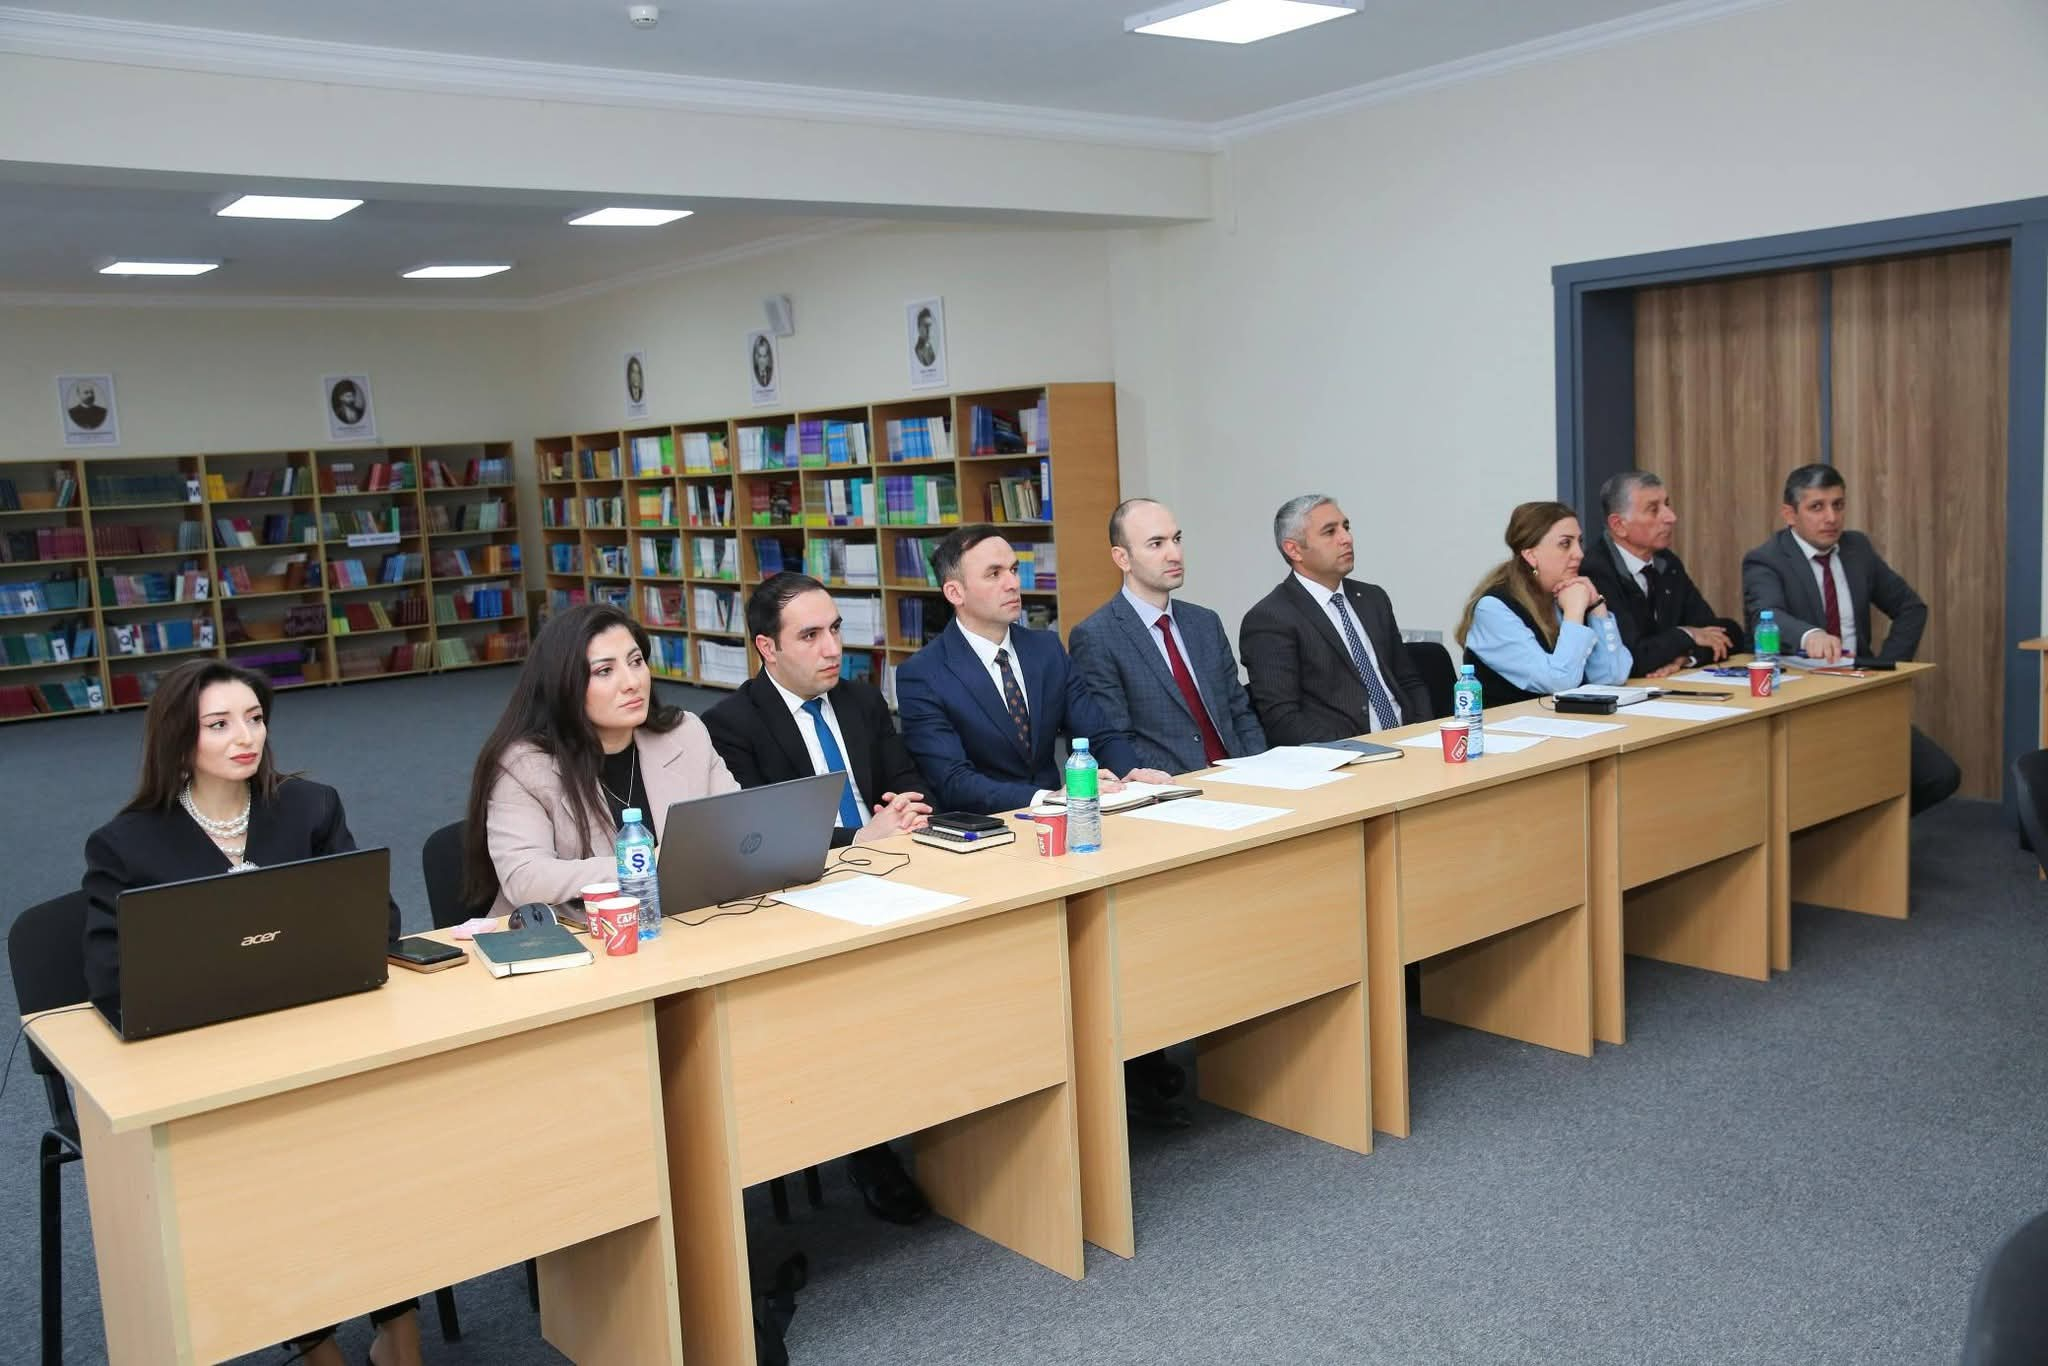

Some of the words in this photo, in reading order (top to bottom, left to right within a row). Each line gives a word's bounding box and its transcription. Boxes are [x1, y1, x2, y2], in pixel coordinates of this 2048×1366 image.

[188, 486, 201, 497] M
[197, 583, 206, 594] X
[23, 597, 36, 608] H
[55, 644, 65, 656] T
[89, 691, 101, 703] G
[240, 930, 281, 947] acer
